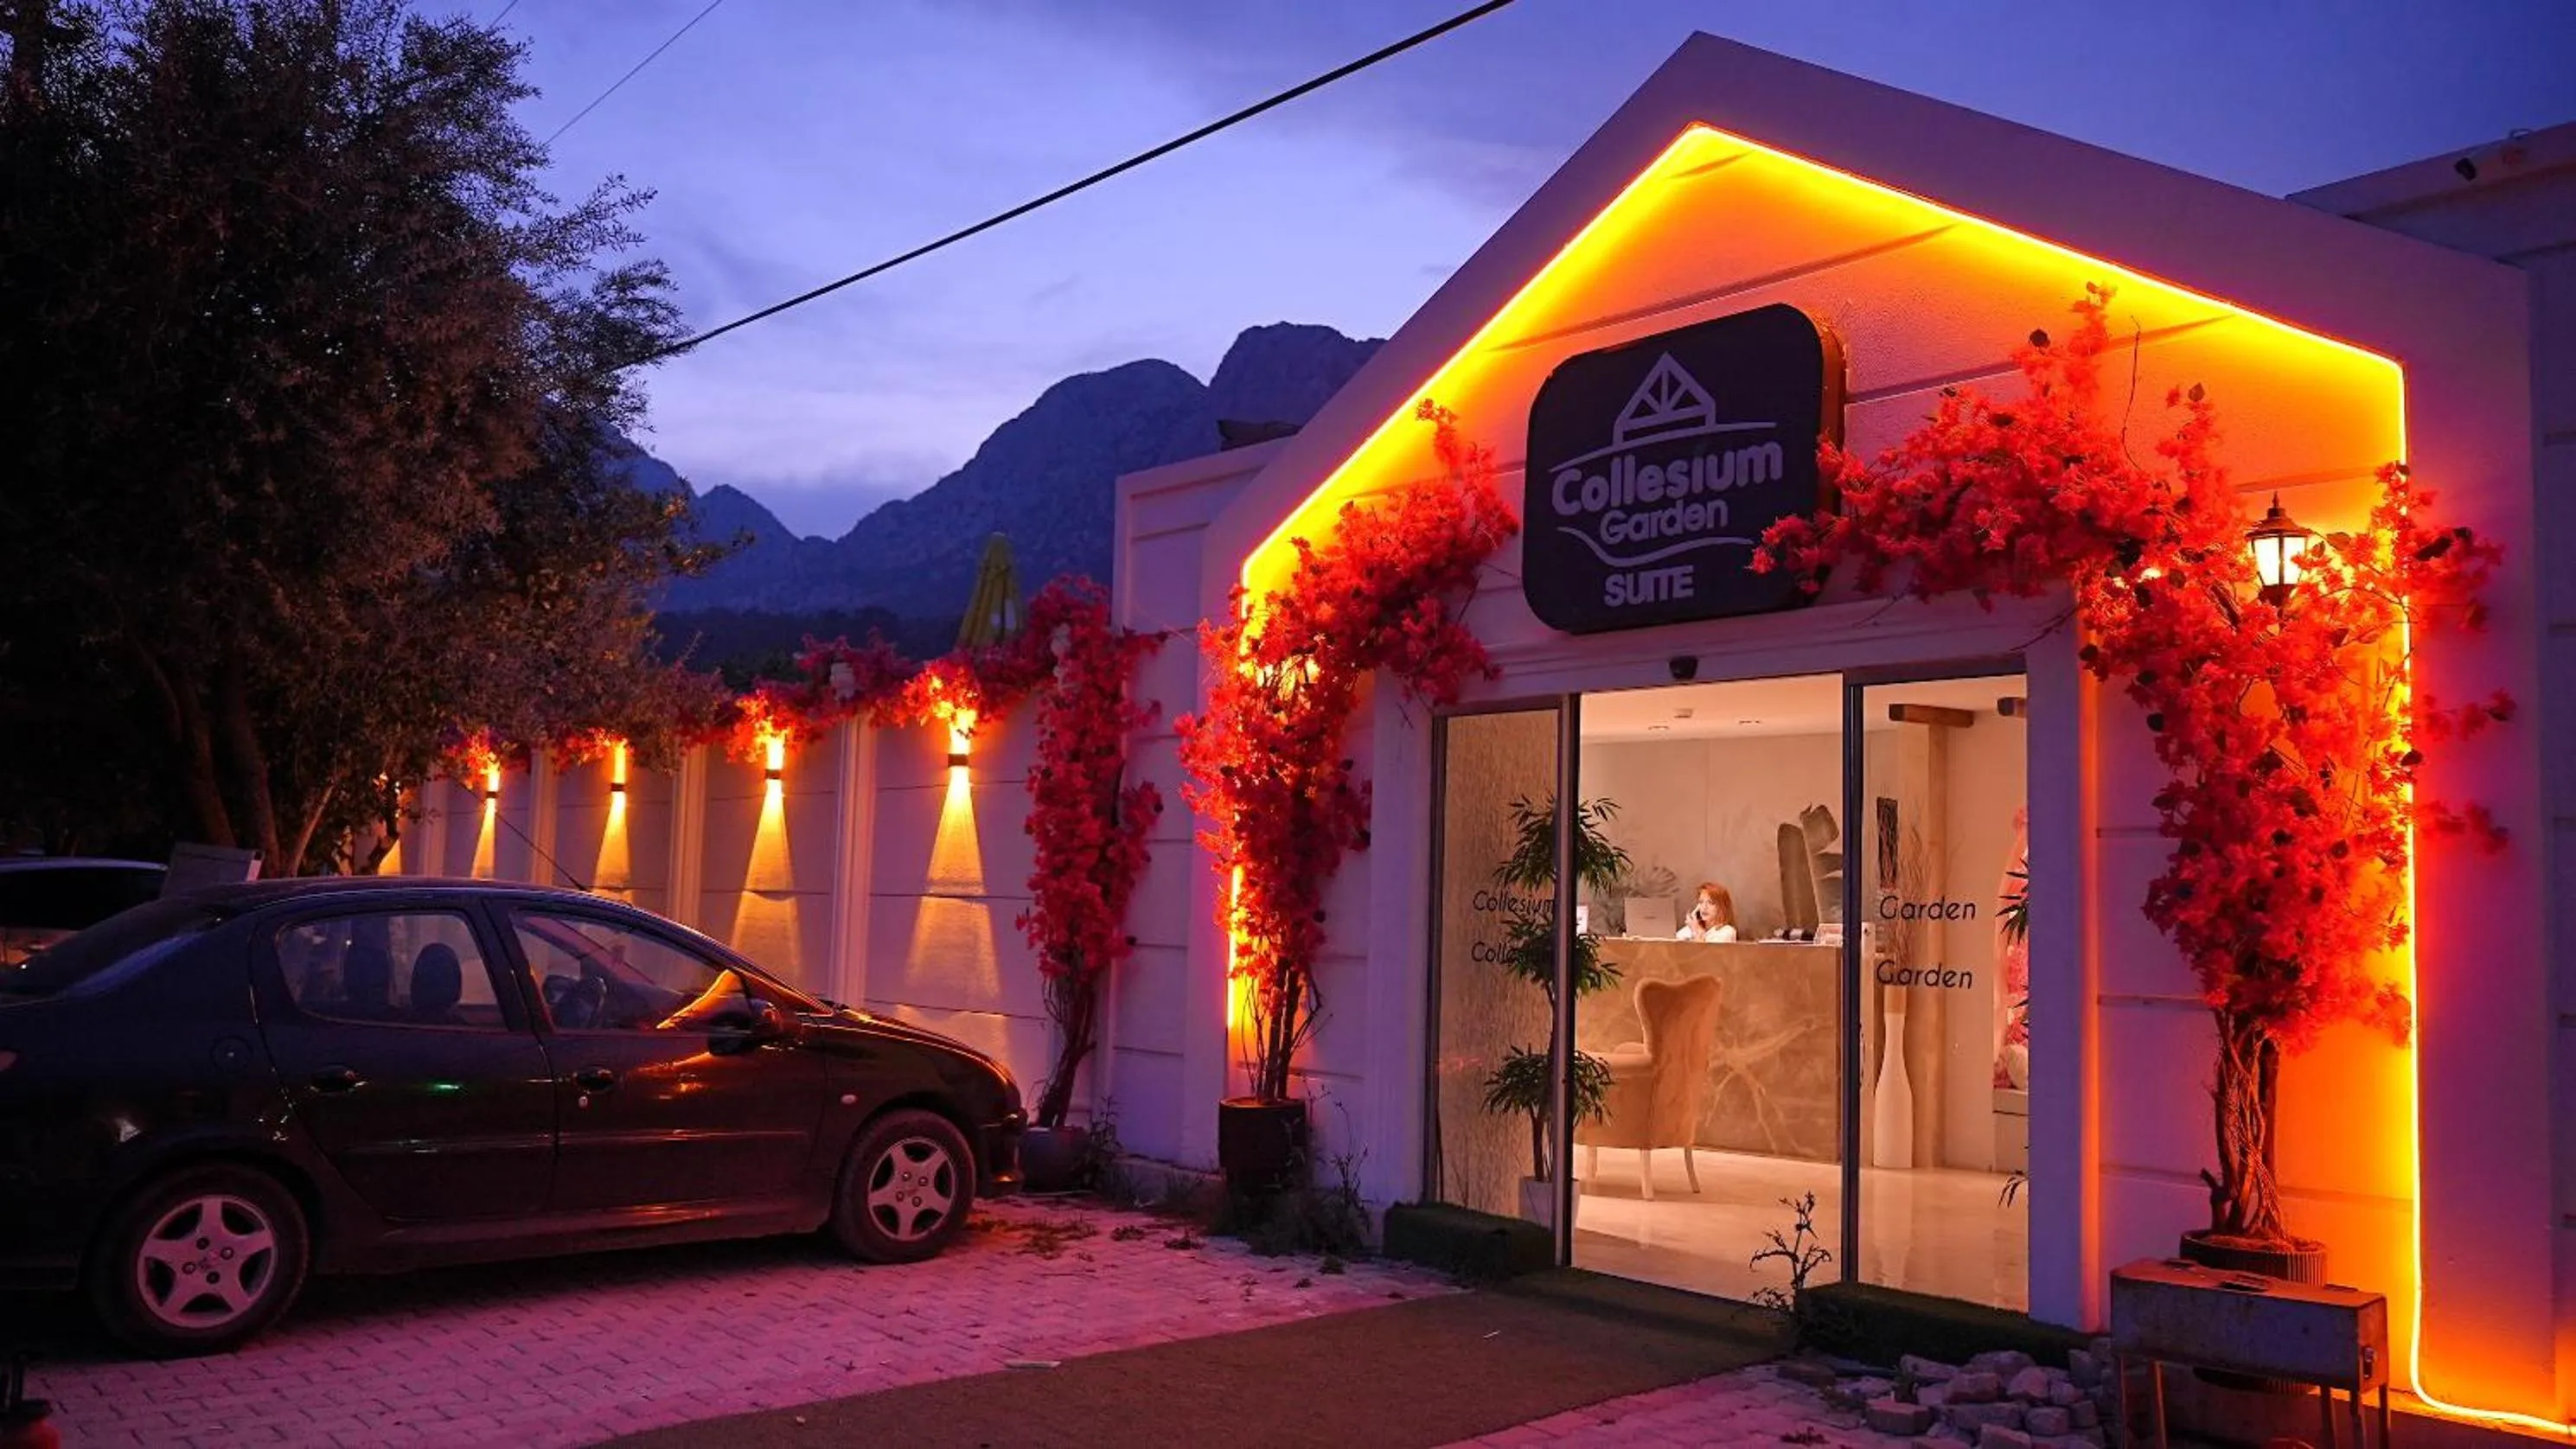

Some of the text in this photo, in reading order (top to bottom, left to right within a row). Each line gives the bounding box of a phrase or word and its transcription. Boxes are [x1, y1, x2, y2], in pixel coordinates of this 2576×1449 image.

[1551, 441, 1783, 516] Collesium
[1600, 499, 1729, 545] Garden
[1604, 565, 1694, 607] SUITE
[1879, 895, 1976, 920] Garden
[1876, 959, 1972, 989] Garden
